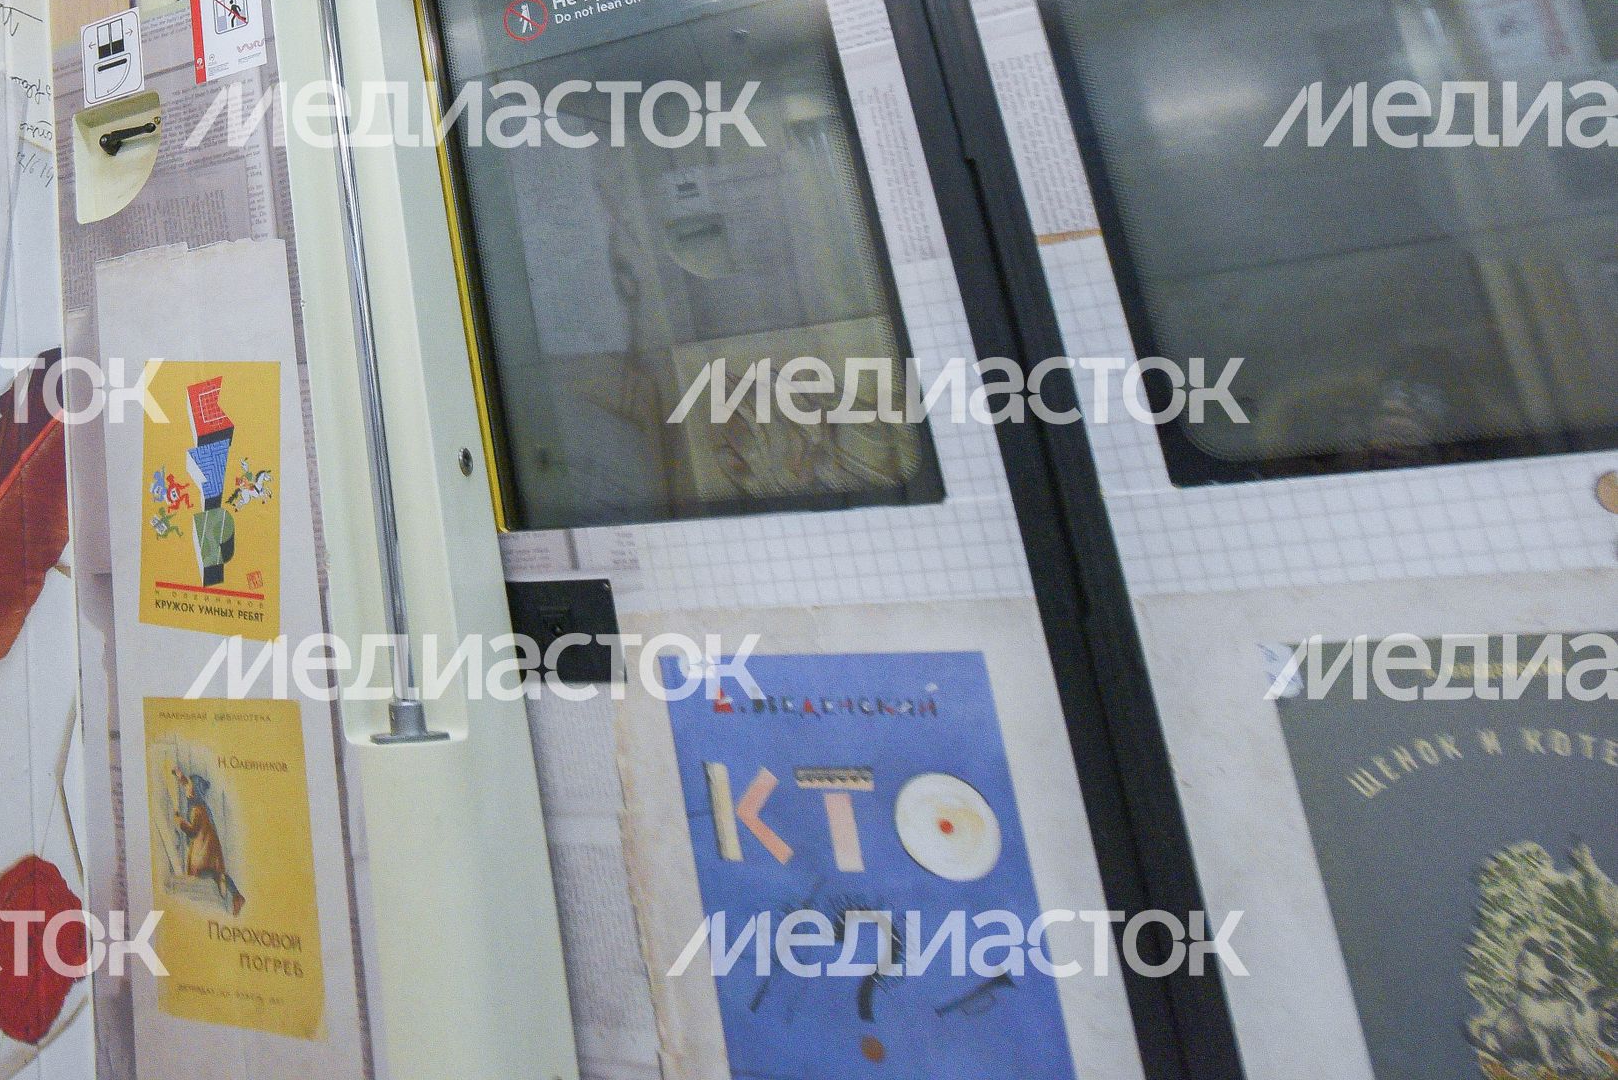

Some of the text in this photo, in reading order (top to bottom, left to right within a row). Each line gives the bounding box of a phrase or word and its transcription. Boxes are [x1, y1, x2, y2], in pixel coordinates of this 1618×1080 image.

[555, 13, 571, 24] Do
[574, 5, 594, 20] not
[155, 599, 265, 622] КРУЖОК УМНЫХ РЕБЯТ
[1346, 734, 1463, 799] ЩЕНОК
[1477, 728, 1503, 755] И
[702, 761, 1002, 882] КТО
[239, 952, 303, 979] ПОГРЕБ
